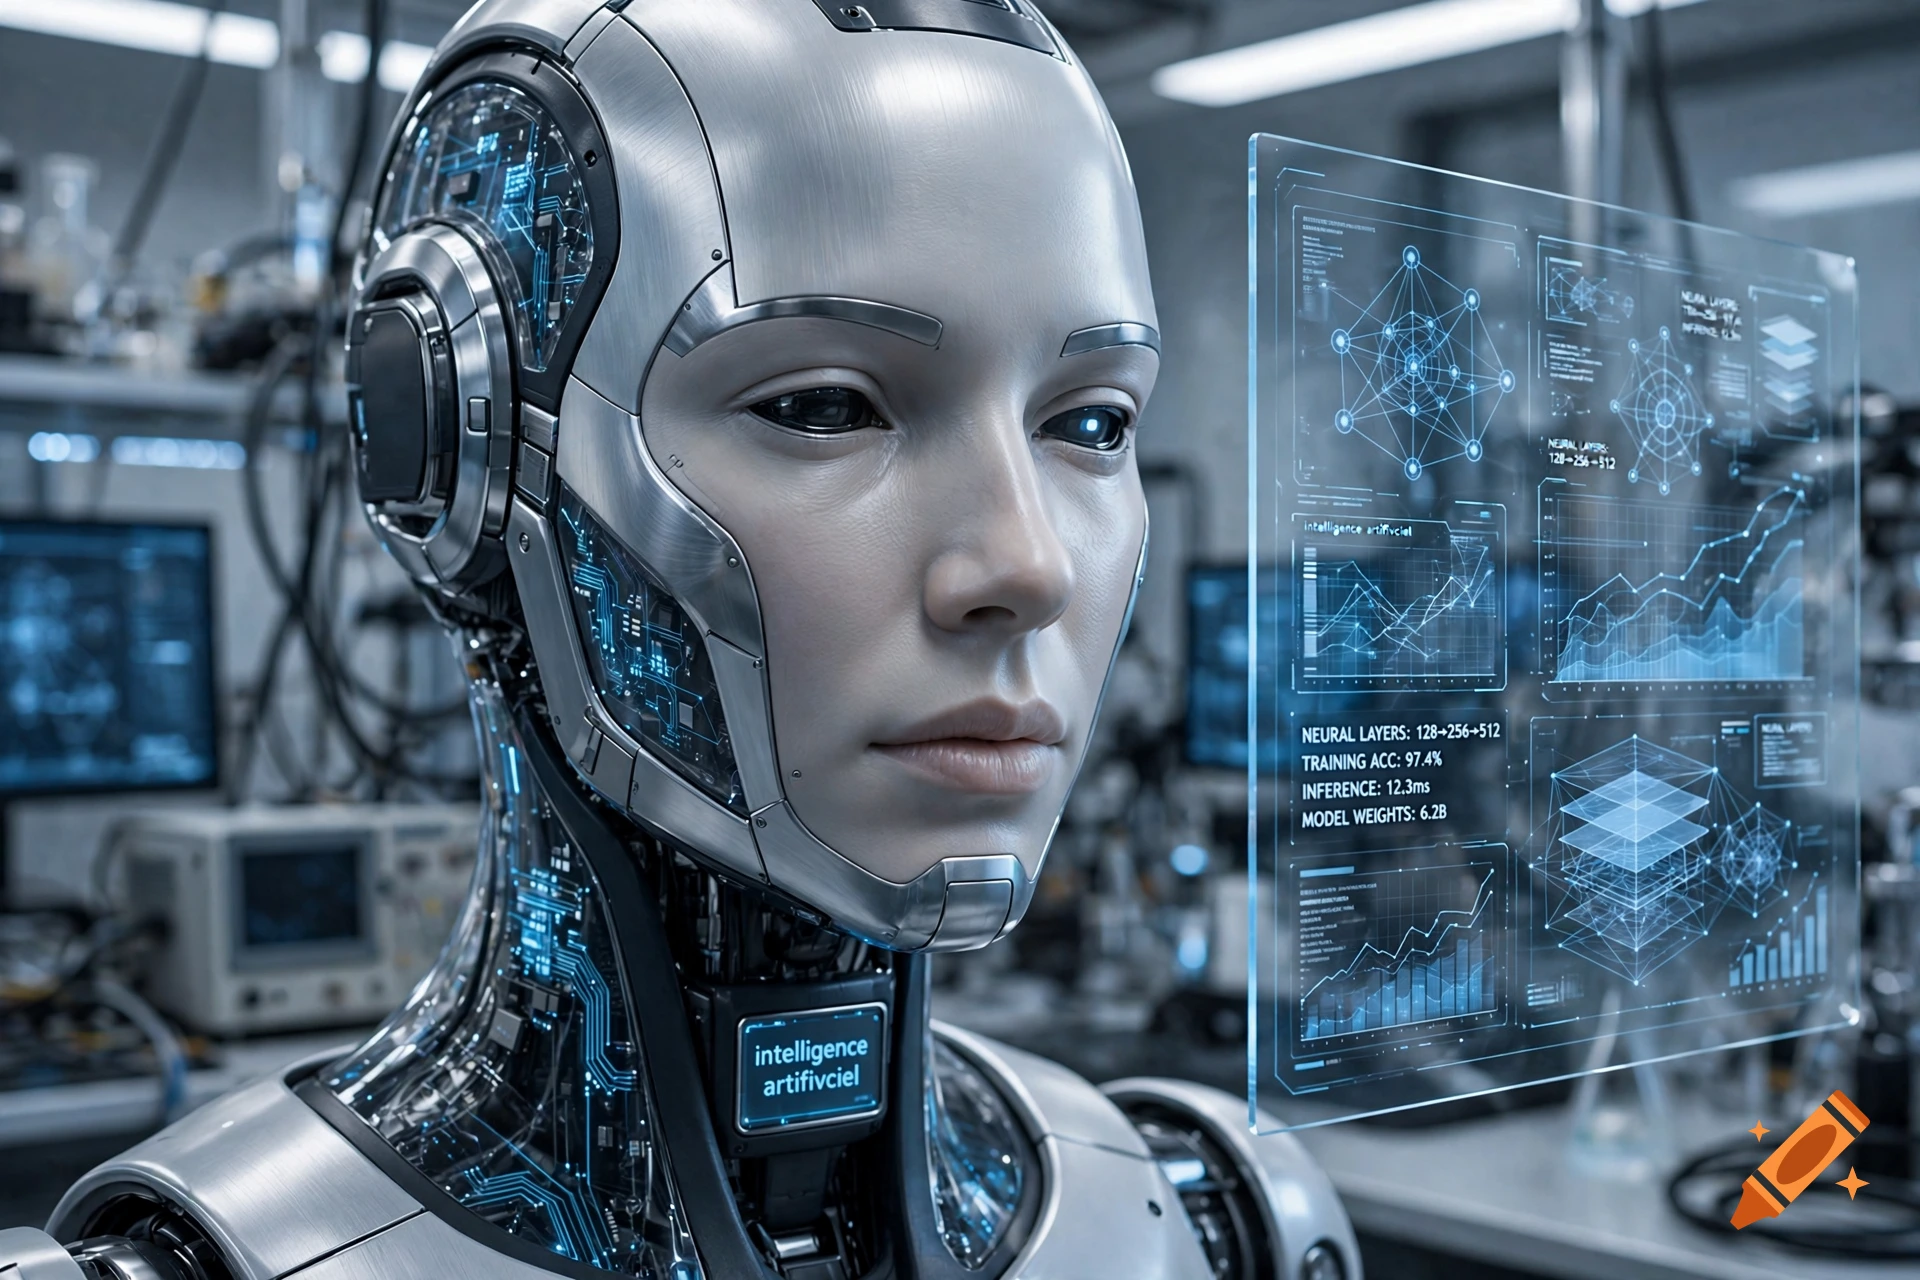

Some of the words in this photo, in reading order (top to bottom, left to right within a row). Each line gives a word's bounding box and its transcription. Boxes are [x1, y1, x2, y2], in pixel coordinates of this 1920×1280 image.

[1304, 520, 1362, 536] intelligence
[1302, 726, 1356, 744] NEURAL
[1360, 725, 1411, 742] LAYERS:
[1302, 754, 1367, 772] TRAINING
[1370, 753, 1401, 770] ACC:
[1405, 750, 1443, 768] 97.4%
[1302, 779, 1381, 800] INFERENCE:
[1387, 778, 1431, 796] 12.3ms
[1302, 811, 1350, 829] MODEL
[1353, 806, 1416, 825] WEIGHTS:
[1420, 804, 1447, 821] 6.2B
[755, 1038, 869, 1067] intelligence
[763, 1064, 860, 1097] artifivciel
